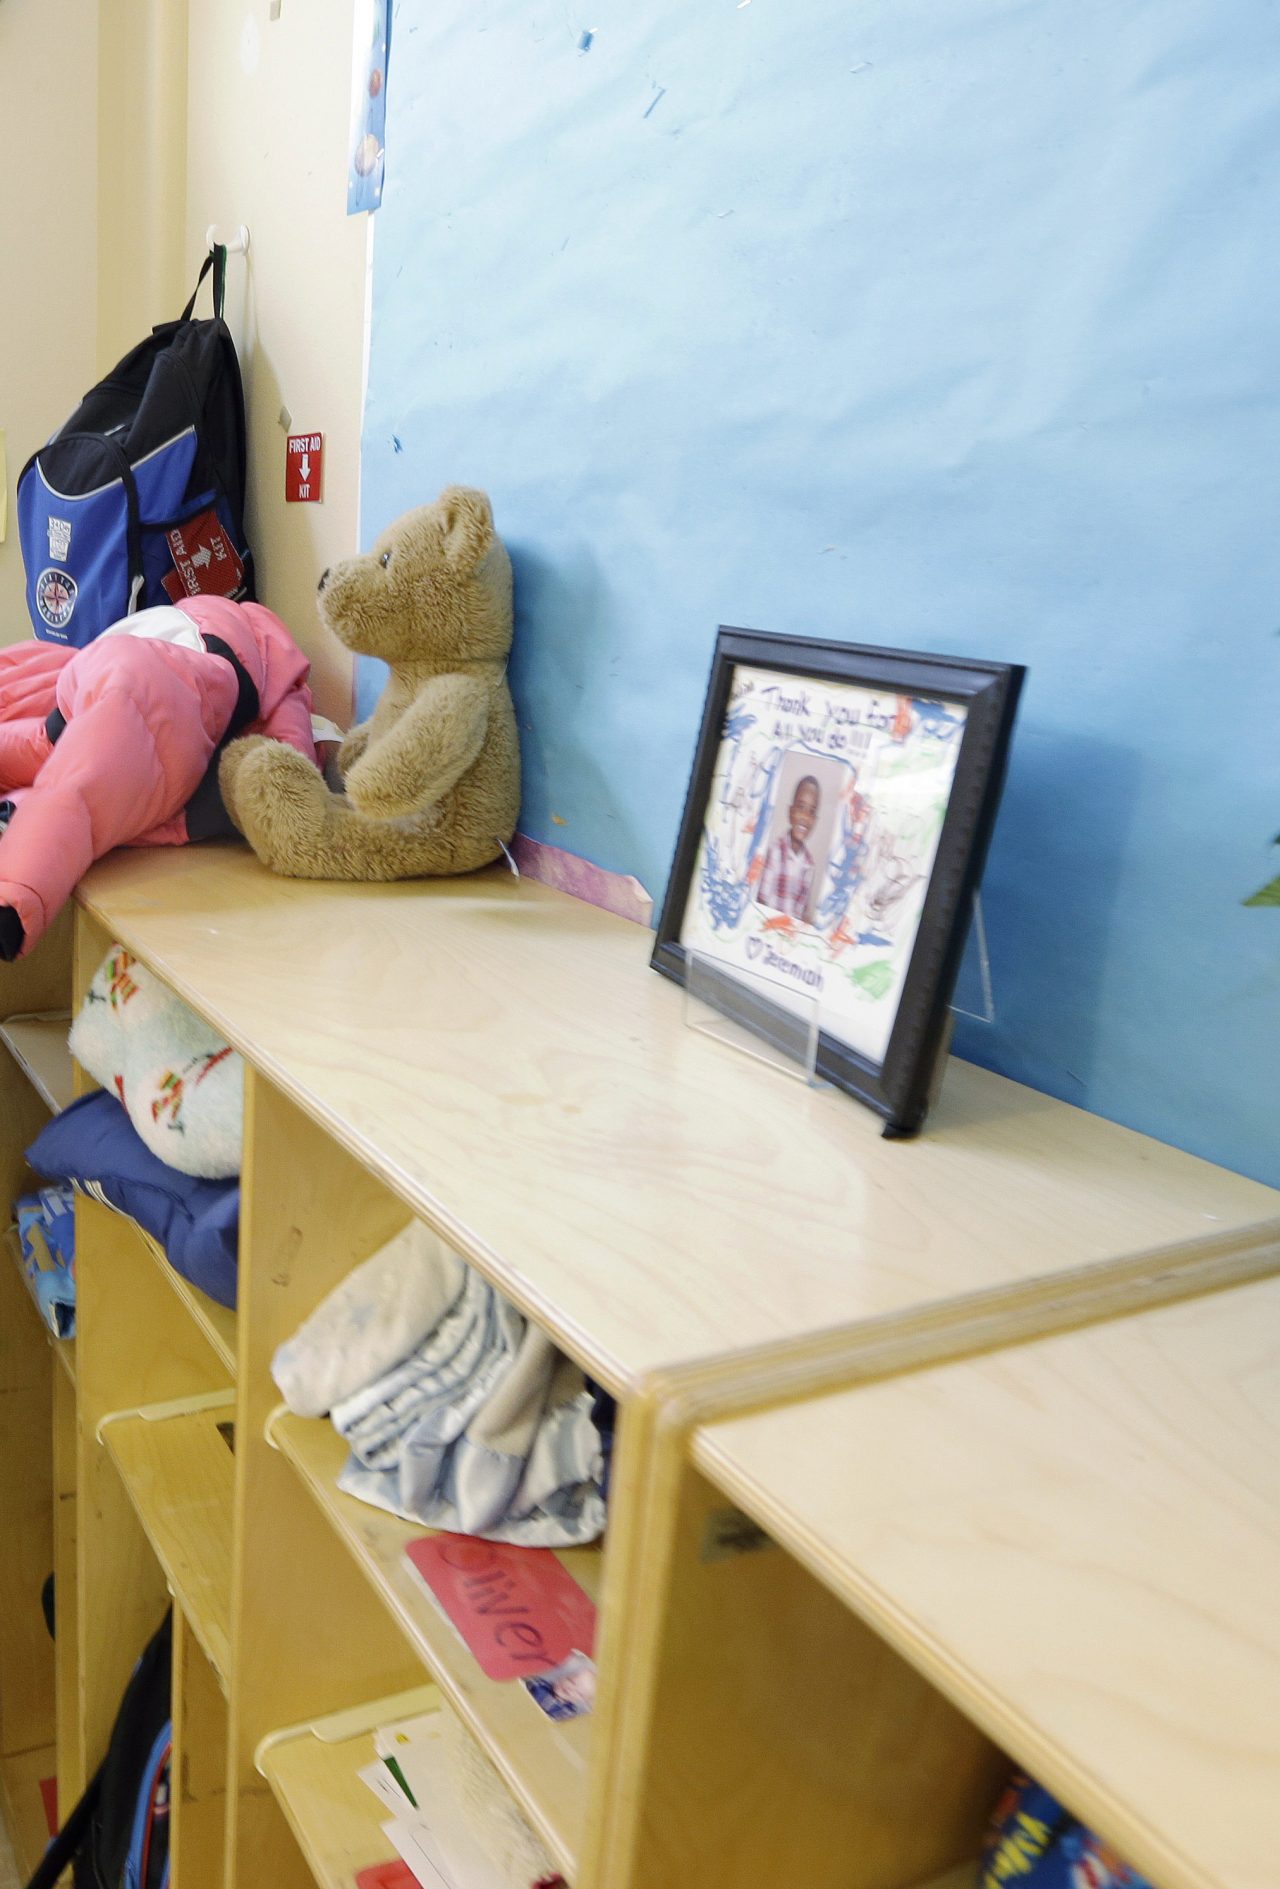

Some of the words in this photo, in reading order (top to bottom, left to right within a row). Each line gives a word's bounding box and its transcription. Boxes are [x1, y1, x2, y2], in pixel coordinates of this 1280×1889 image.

[289, 438, 310, 454] FIRST
[310, 436, 321, 452] AID
[298, 484, 310, 498] KIT
[170, 528, 187, 556] AID
[210, 536, 227, 561] KIT
[762, 686, 811, 717] Thank
[763, 942, 825, 994] Jeremiah
